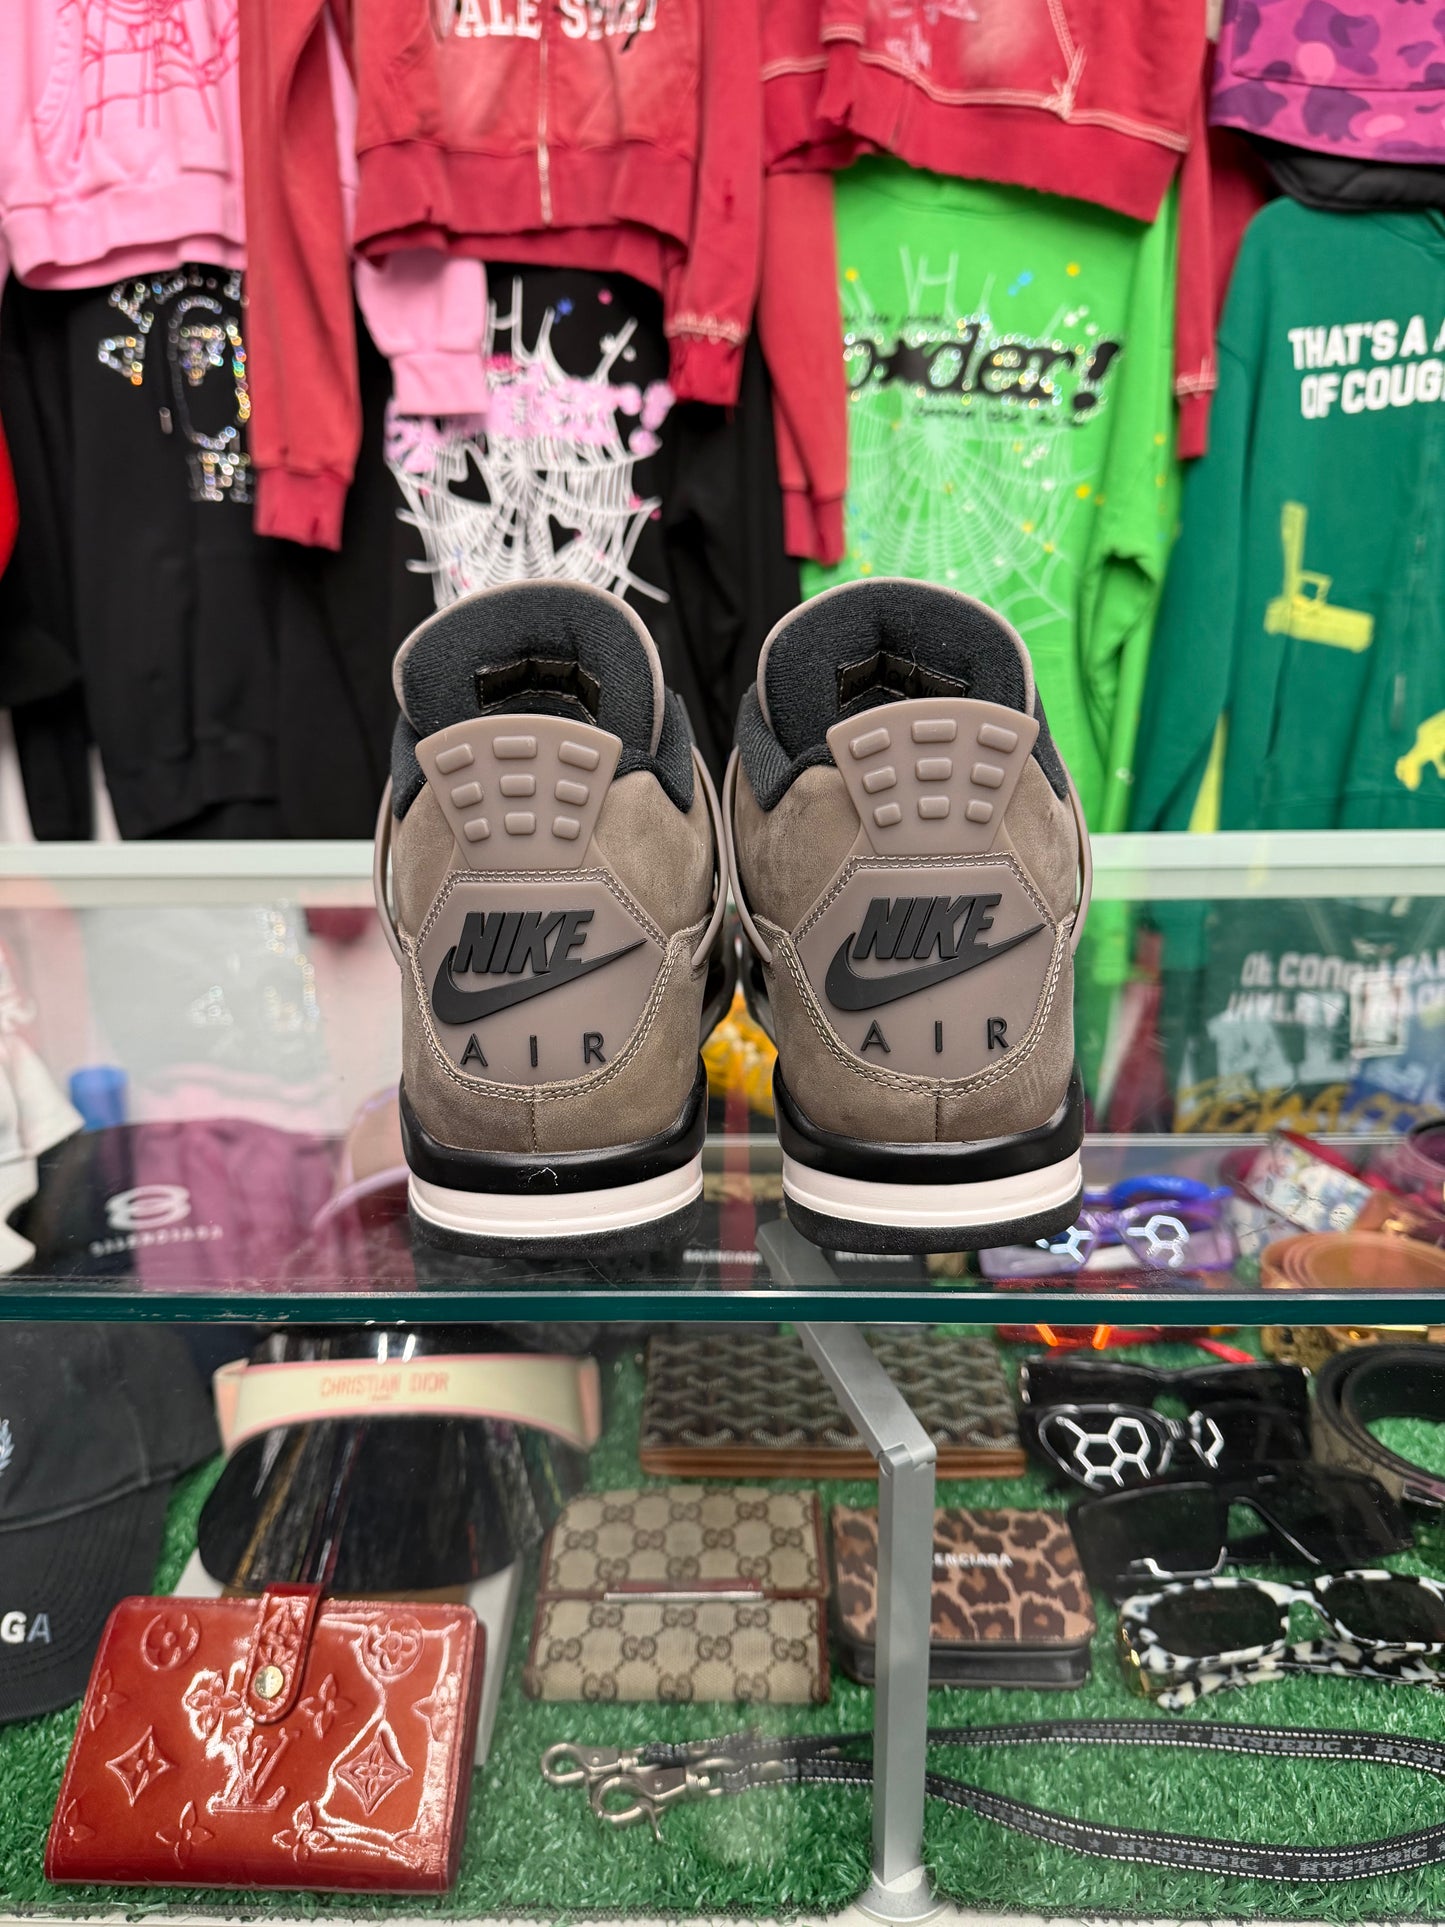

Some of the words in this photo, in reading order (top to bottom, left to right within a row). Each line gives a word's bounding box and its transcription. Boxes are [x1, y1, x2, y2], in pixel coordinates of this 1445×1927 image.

[1288, 319, 1399, 370] THAT'S
[1400, 314, 1428, 357] A
[1301, 374, 1341, 419] OF
[1341, 358, 1445, 414] COUG
[452, 909, 595, 974] NIKE
[853, 893, 1002, 959] NIKE
[460, 1031, 606, 1067] AIR
[860, 1016, 1009, 1053] AIR
[320, 1373, 401, 1397] CHRISTIAN
[409, 1371, 449, 1393] DIOR
[1210, 1732, 1342, 1754] HYSTERIC
[1116, 1840, 1259, 1872] HYSTERIC
[1298, 1845, 1429, 1876] HYSTERIC
